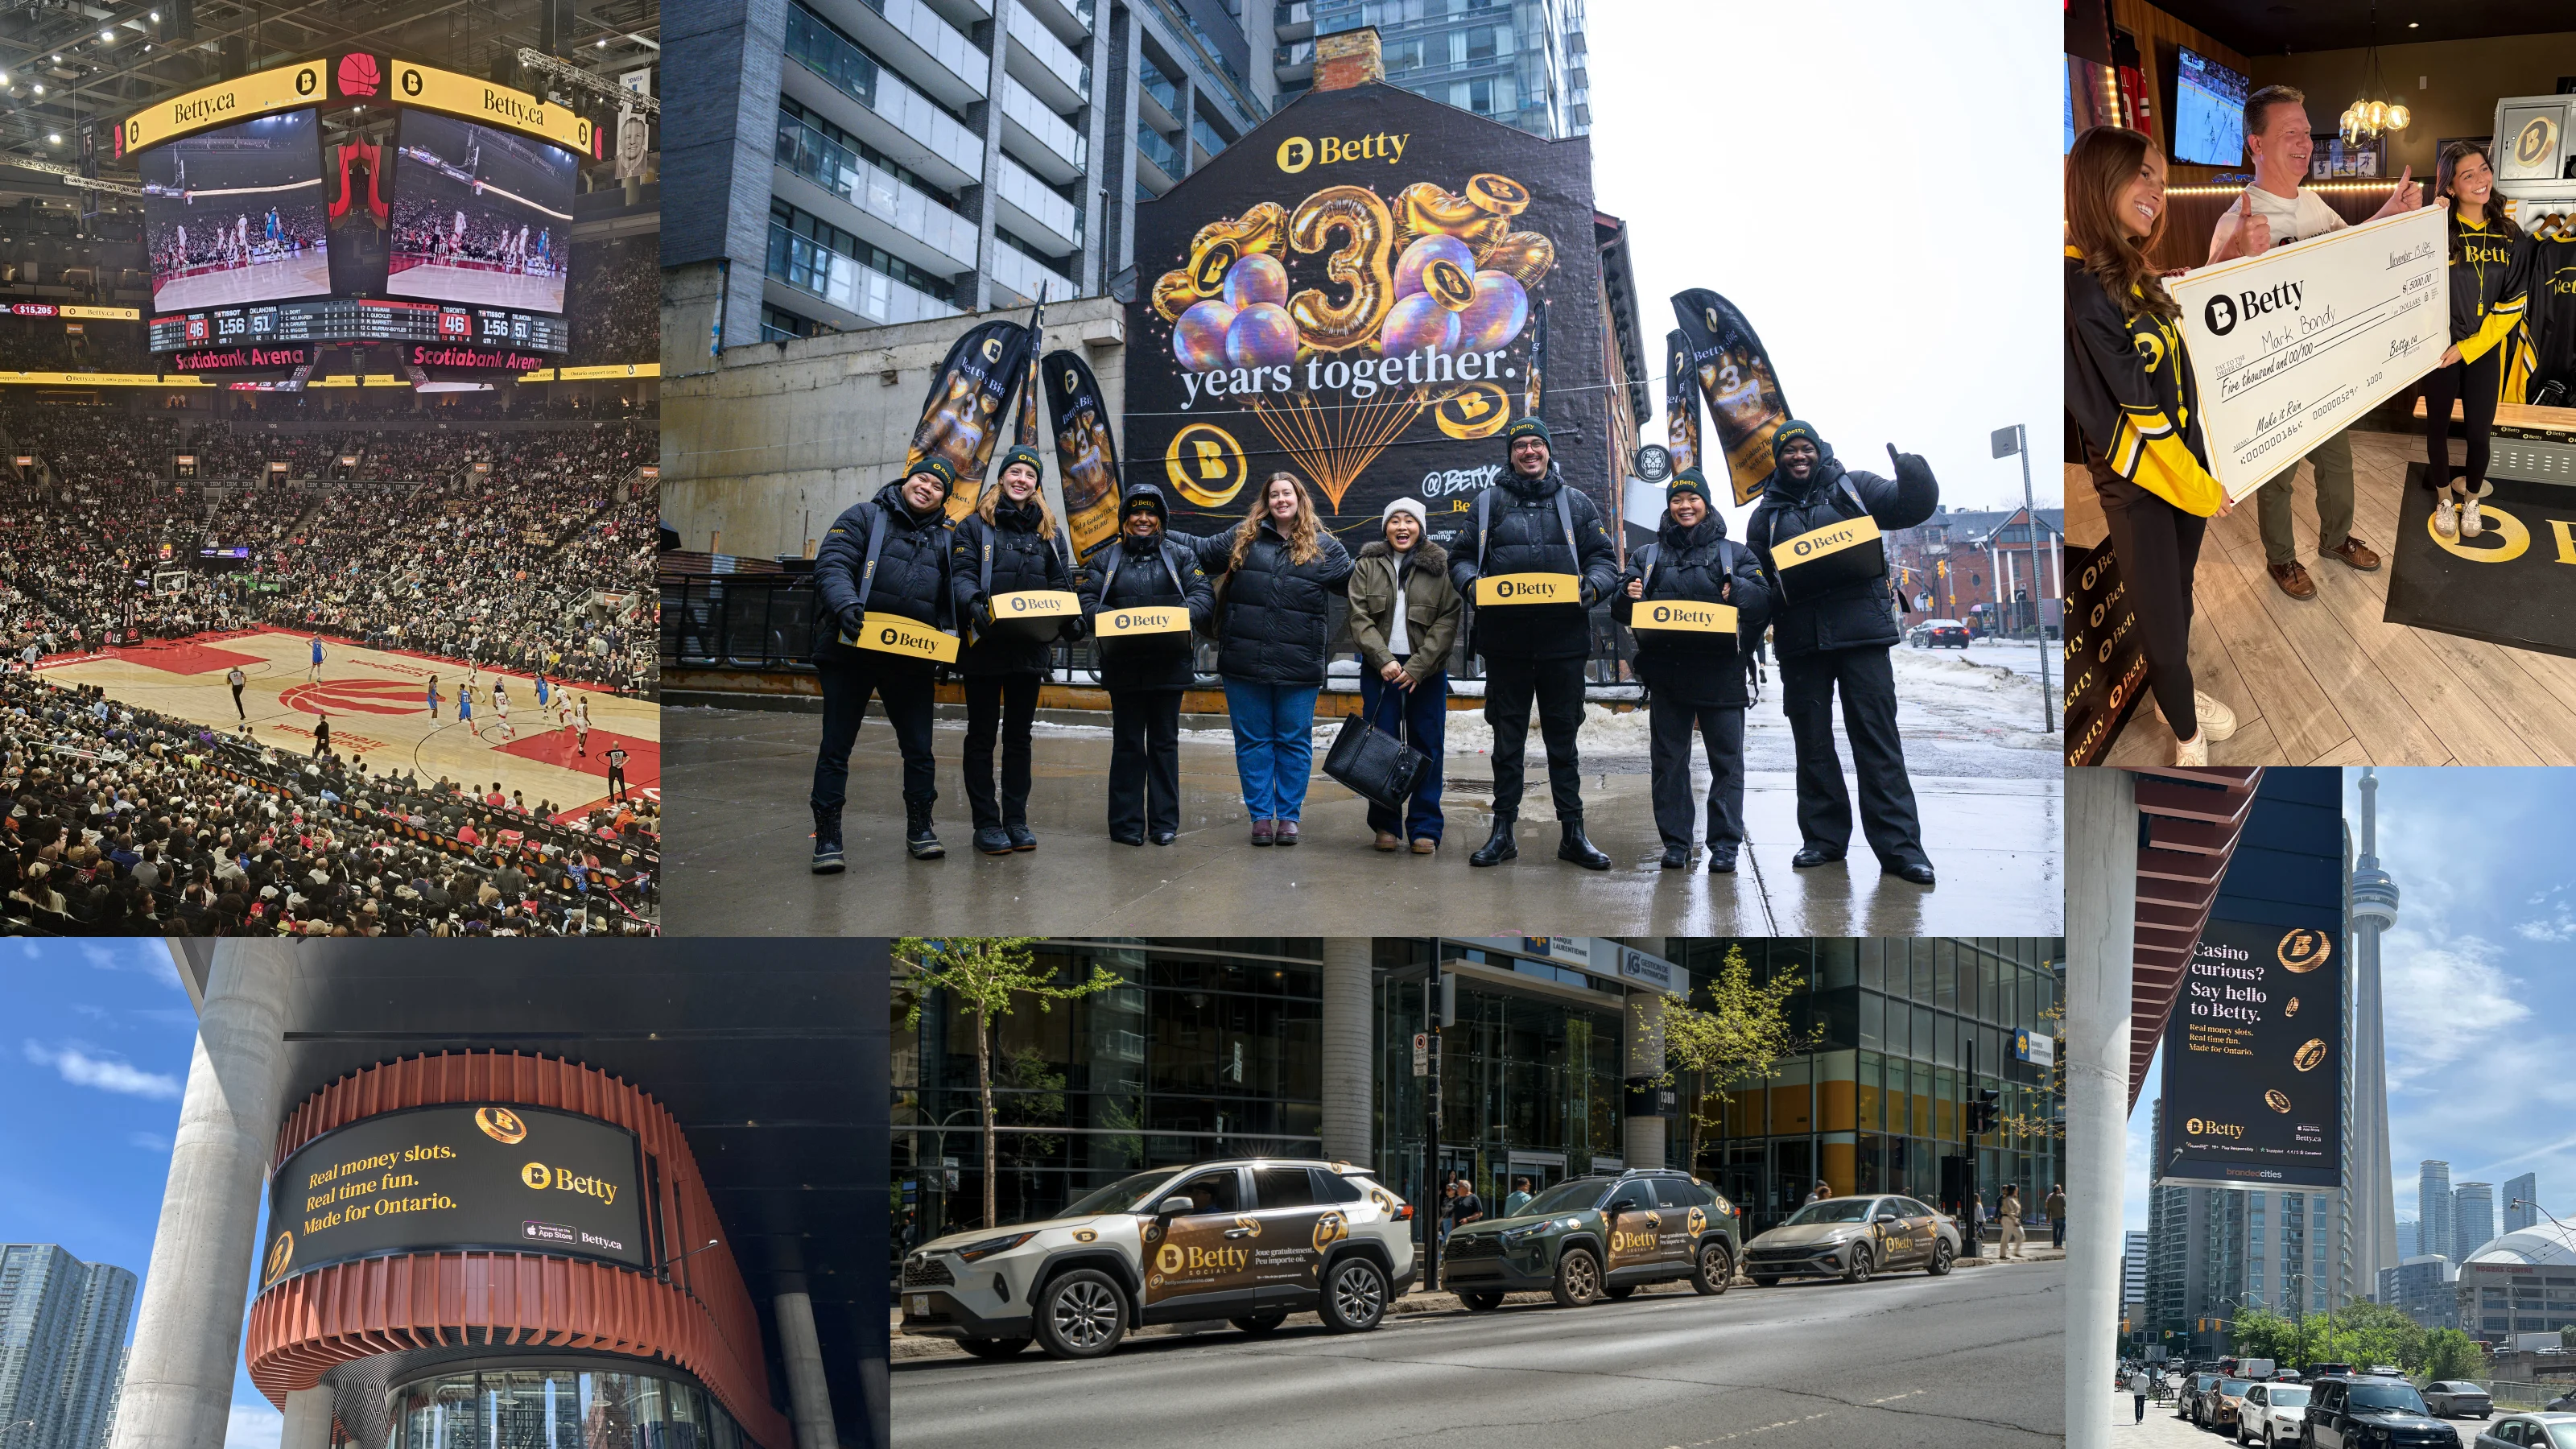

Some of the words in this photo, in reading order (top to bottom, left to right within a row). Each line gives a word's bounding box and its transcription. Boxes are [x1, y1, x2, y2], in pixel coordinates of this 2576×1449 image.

[174, 92, 235, 125] Betty.ca
[484, 89, 543, 126] Betty.ca
[1319, 131, 1410, 165] Betty
[2389, 250, 2413, 268] November
[1288, 185, 1394, 353] 3
[2409, 273, 2432, 291] 5000.00
[2239, 279, 2304, 321] Betty
[2399, 296, 2421, 312] DOLLARS
[20, 305, 52, 315] $15,205
[88, 309, 114, 317] Betty.ca
[221, 309, 241, 317] TISSOT
[250, 306, 277, 314] OKLAHOMA
[486, 311, 506, 319] TISSOT
[190, 322, 204, 337] 46
[218, 318, 245, 335] 1:56
[254, 316, 270, 332] 51
[445, 317, 464, 332] 46
[483, 319, 508, 336] 1:56
[515, 322, 527, 338] 51
[2261, 325, 2294, 353] Mark
[2299, 303, 2335, 335] Bondy
[2389, 334, 2417, 357] Betty.ca
[2402, 345, 2421, 358] SIGNATURE
[175, 350, 249, 370] Scotiabank
[252, 349, 303, 365] Arena
[413, 345, 502, 367] Scotiabank
[506, 352, 542, 370] Arena
[2215, 362, 2227, 372] PAY
[2235, 353, 2246, 363] THE
[961, 356, 989, 385] Betty's
[989, 379, 1005, 398] Big
[1180, 361, 1291, 410] years
[1307, 345, 1515, 398] together.
[2216, 366, 2235, 378] ORDER
[2235, 361, 2243, 369] OF
[2221, 377, 2240, 398] Five
[2242, 357, 2275, 387] thousand
[2276, 350, 2288, 370] and
[2289, 342, 2314, 364] 00/100
[1719, 365, 1741, 393] 3
[2366, 371, 2383, 387] 1000
[2256, 411, 2277, 436] Make
[2278, 408, 2286, 422] it
[2286, 399, 2302, 417] Rain
[1786, 427, 1806, 436] Betty
[2233, 437, 2250, 451] MEMO
[1027, 456, 1042, 469] Betty
[939, 467, 953, 485] Betty
[1678, 479, 1698, 489] Betty
[1137, 499, 1156, 508] Betty
[1087, 514, 1104, 526] Golden
[1103, 503, 1118, 518] Ticket,
[1093, 518, 1109, 530] $1,000!
[1812, 528, 1854, 550] Betty
[160, 550, 170, 559] 24
[1516, 579, 1557, 597] Betty
[1027, 597, 1062, 611] Betty
[1133, 613, 1170, 628] Betty
[1672, 609, 1715, 627] Betty
[113, 633, 121, 643] LG
[898, 634, 939, 654] Betty
[348, 658, 428, 678] Scotiabank
[330, 731, 391, 749] Arena
[2069, 712, 2104, 766] Betty
[1553, 943, 1587, 957] LAURENTIENNE
[2194, 941, 2249, 962] Casino
[1641, 958, 1662, 970] GESTION
[1662, 965, 1669, 973] DE
[2190, 962, 2264, 982] curious?
[1641, 967, 1669, 983] PATRIMOINE
[2190, 981, 2221, 1002] Say
[2225, 985, 2267, 1004] hello
[2190, 1001, 2208, 1017] to
[2212, 1002, 2261, 1025] Betty.
[2190, 1023, 2206, 1032] Real
[2207, 1026, 2233, 1036] money
[2234, 1028, 2254, 1036] slots.
[2189, 1033, 2206, 1042] Real
[2207, 1035, 2225, 1043] time
[2225, 1036, 2240, 1045] fun.
[2189, 1043, 2210, 1051] Made
[2211, 1045, 2223, 1053] for
[2223, 1046, 2254, 1056] Ontario.
[1660, 1091, 1675, 1104] 1360
[2205, 1120, 2245, 1140] Betty
[2295, 1134, 2322, 1143] Betty.ca
[308, 1164, 339, 1190] Real
[341, 1150, 400, 1177] money
[404, 1145, 456, 1162] slots.
[2226, 1167, 2282, 1179] brandedcities
[306, 1189, 336, 1213] Real
[340, 1180, 378, 1201] time
[381, 1174, 419, 1191] fun.
[555, 1167, 617, 1206] Betty
[303, 1212, 341, 1236] Made
[345, 1203, 370, 1224] for
[374, 1192, 456, 1217] Ontario.
[538, 1230, 554, 1239] App
[554, 1232, 573, 1240] Store
[581, 1232, 622, 1249] Betty.ca
[1625, 1232, 1657, 1250] Betty
[1255, 1249, 1269, 1257] Joue
[1270, 1247, 1315, 1257] gratuitement.
[1894, 1236, 1913, 1252] Betty
[1187, 1245, 1249, 1273] Betty
[1255, 1257, 1268, 1265] Peu
[1268, 1257, 1294, 1265] importe
[1295, 1255, 1306, 1263] où.
[1188, 1268, 1227, 1276] SOCIAL
[1164, 1278, 1215, 1286] bettysocialcasino.com
